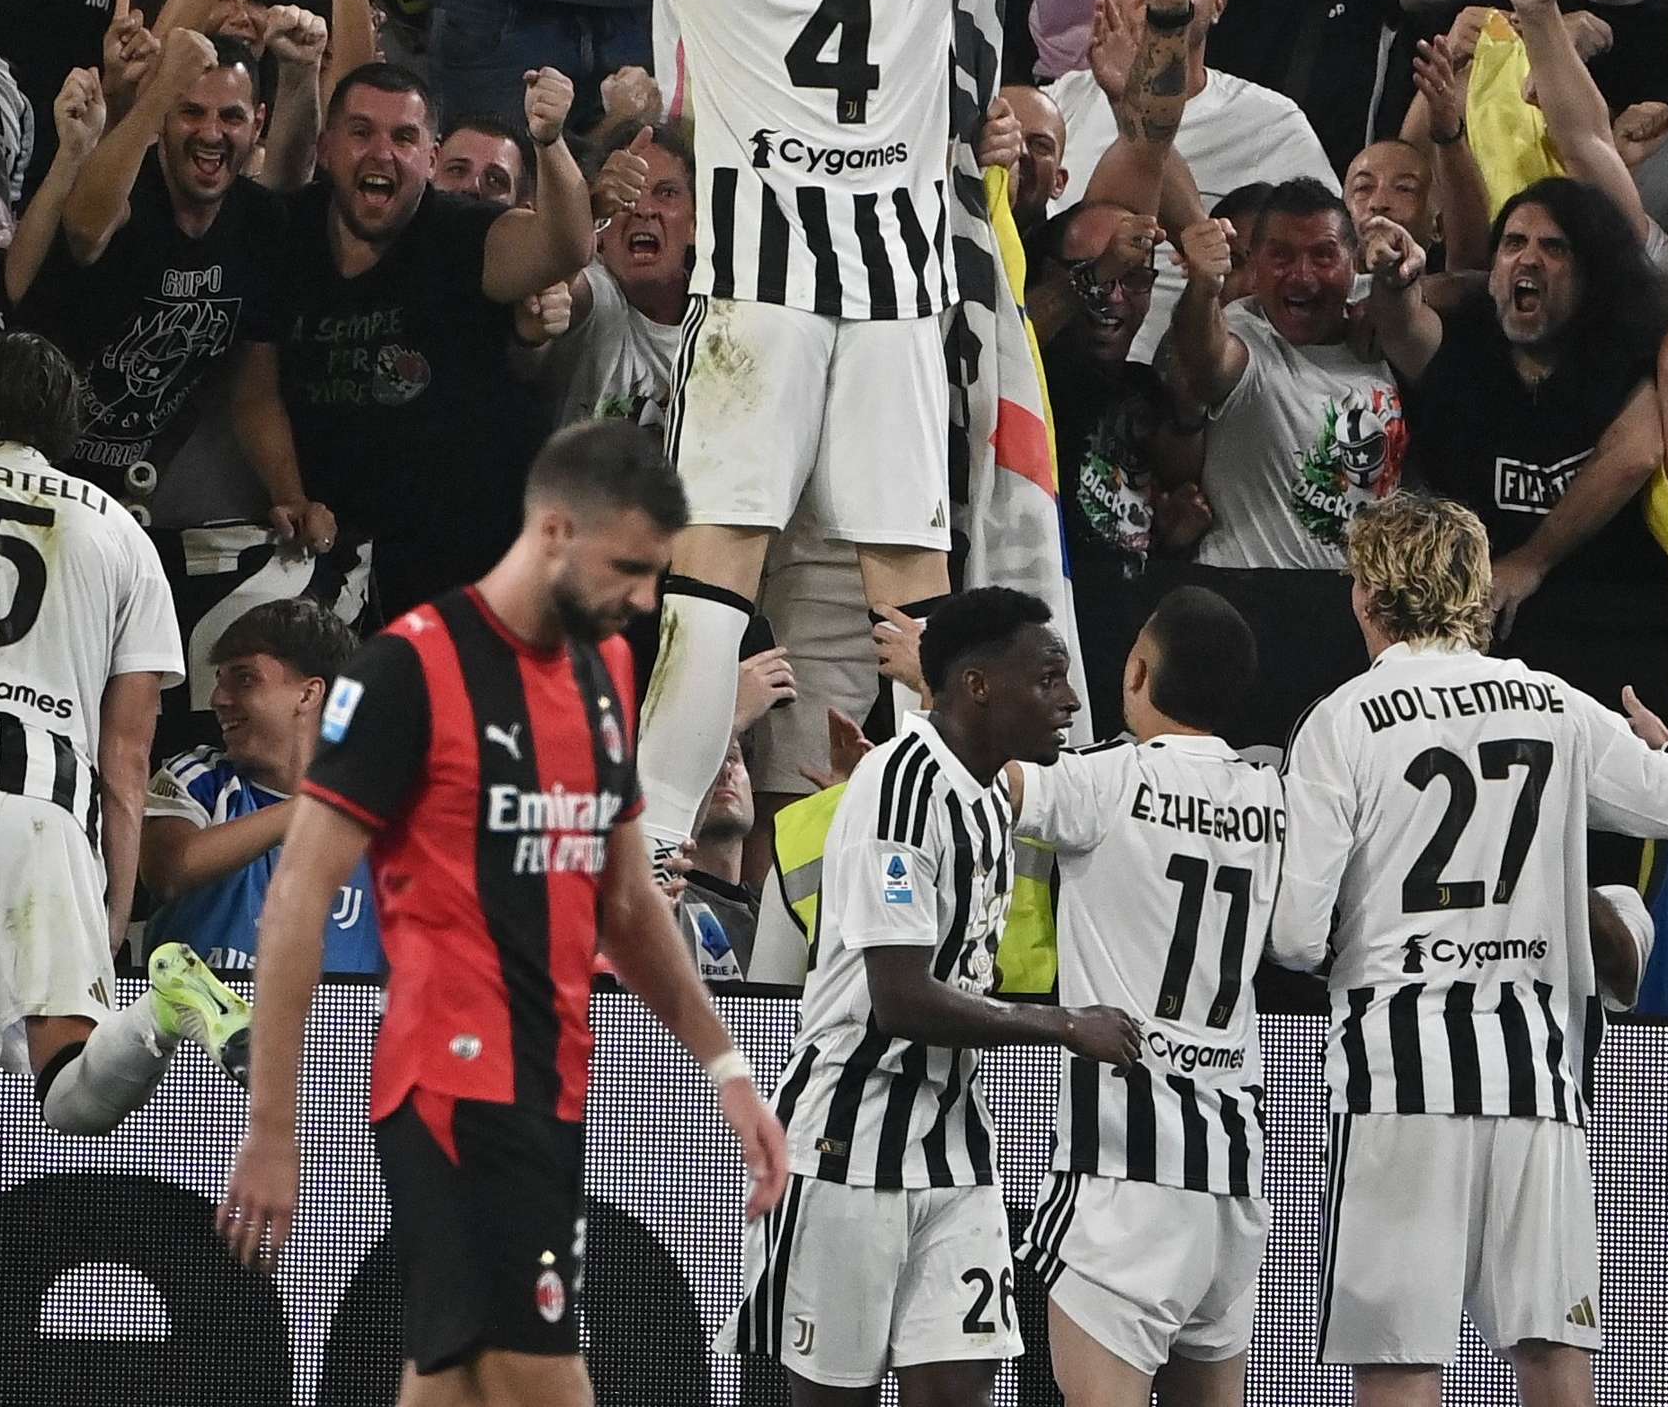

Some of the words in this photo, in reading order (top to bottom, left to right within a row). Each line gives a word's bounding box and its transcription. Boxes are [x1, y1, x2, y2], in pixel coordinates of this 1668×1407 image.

[779, 135, 908, 177] Cygames
[1359, 678, 1565, 734] WOLTEMADE
[1402, 739, 1555, 914] 27
[1155, 852, 1252, 1030] 11
[1431, 933, 1548, 971] Cygames
[700, 964, 728, 976] SERIE
[1147, 1031, 1245, 1073] Cygames
[961, 1268, 1015, 1335] 26
